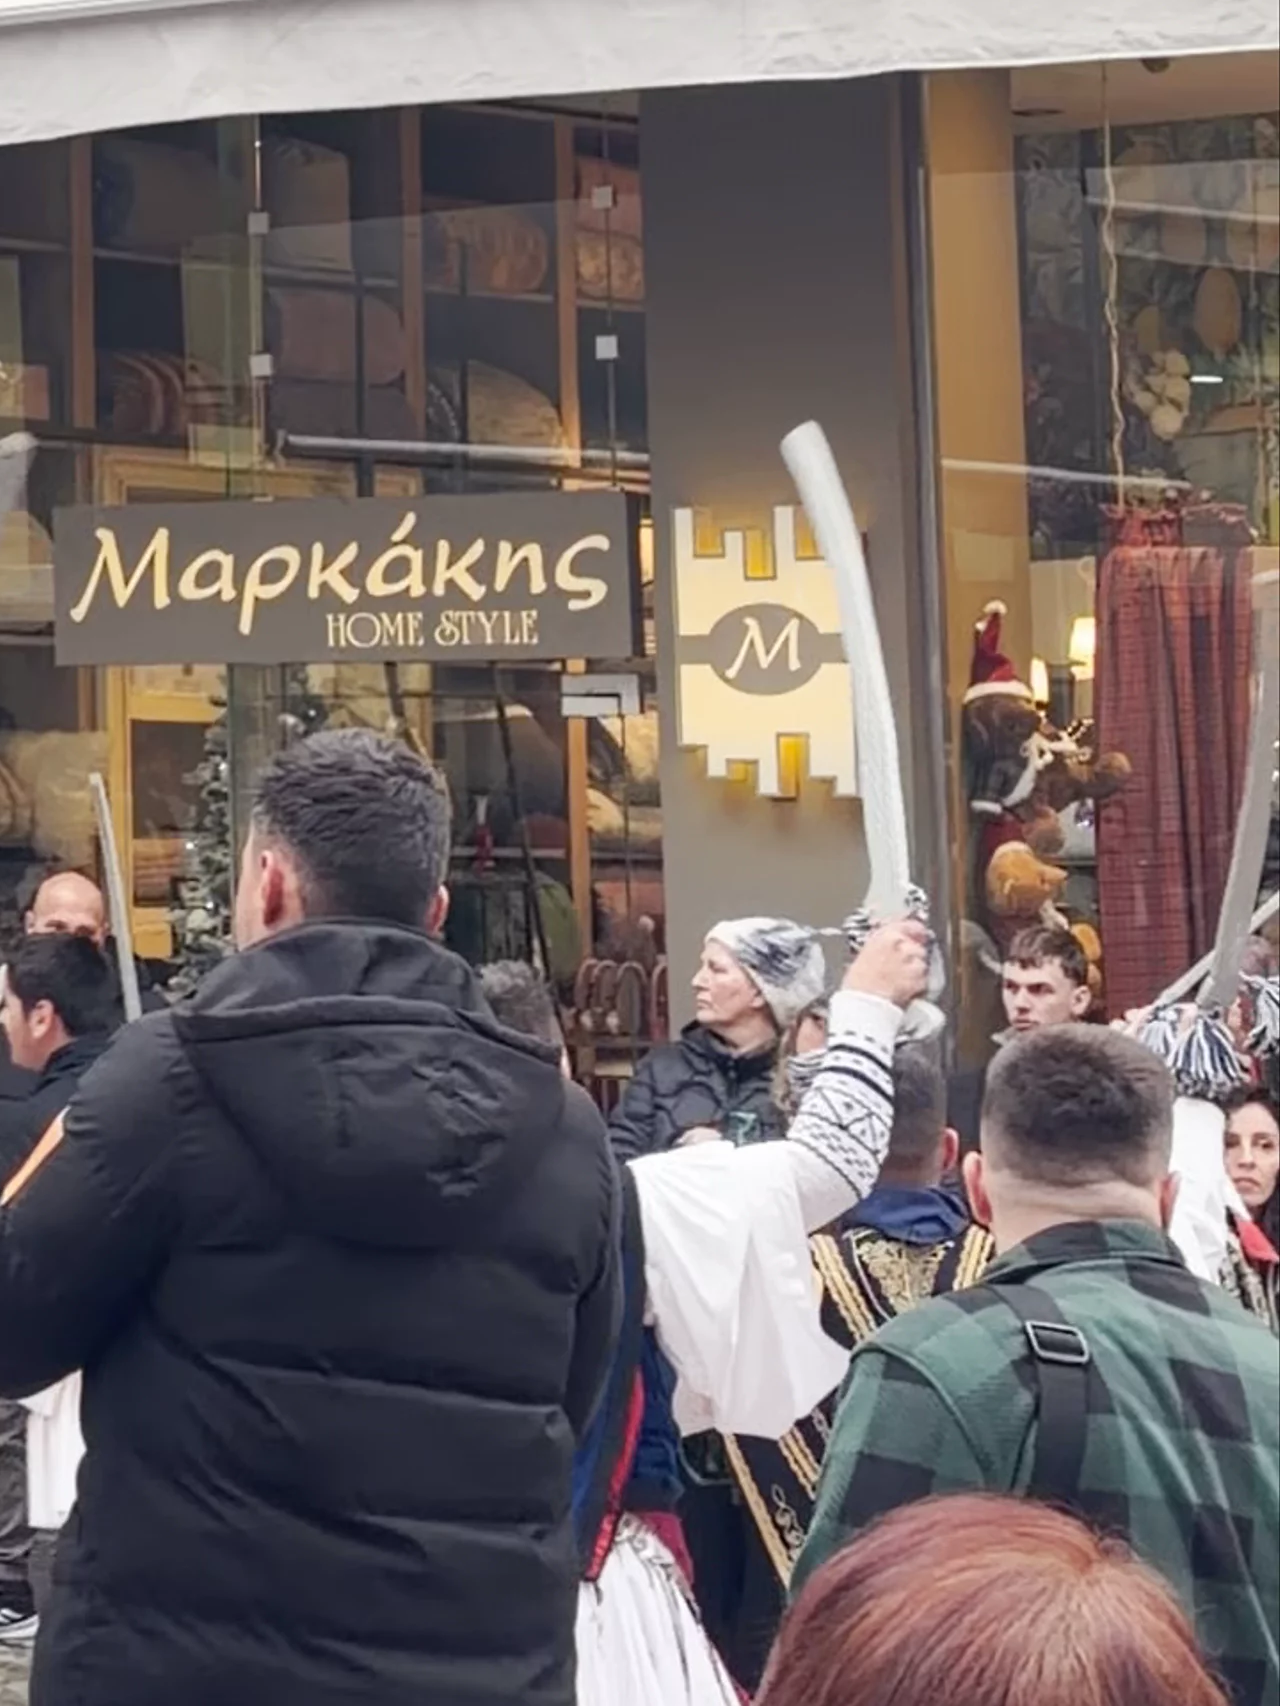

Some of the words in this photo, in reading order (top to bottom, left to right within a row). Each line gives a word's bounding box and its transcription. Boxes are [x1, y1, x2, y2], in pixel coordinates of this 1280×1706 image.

[69, 512, 610, 636] Μαρκάκης
[326, 612, 424, 649] HOME
[433, 608, 538, 647] STYLE
